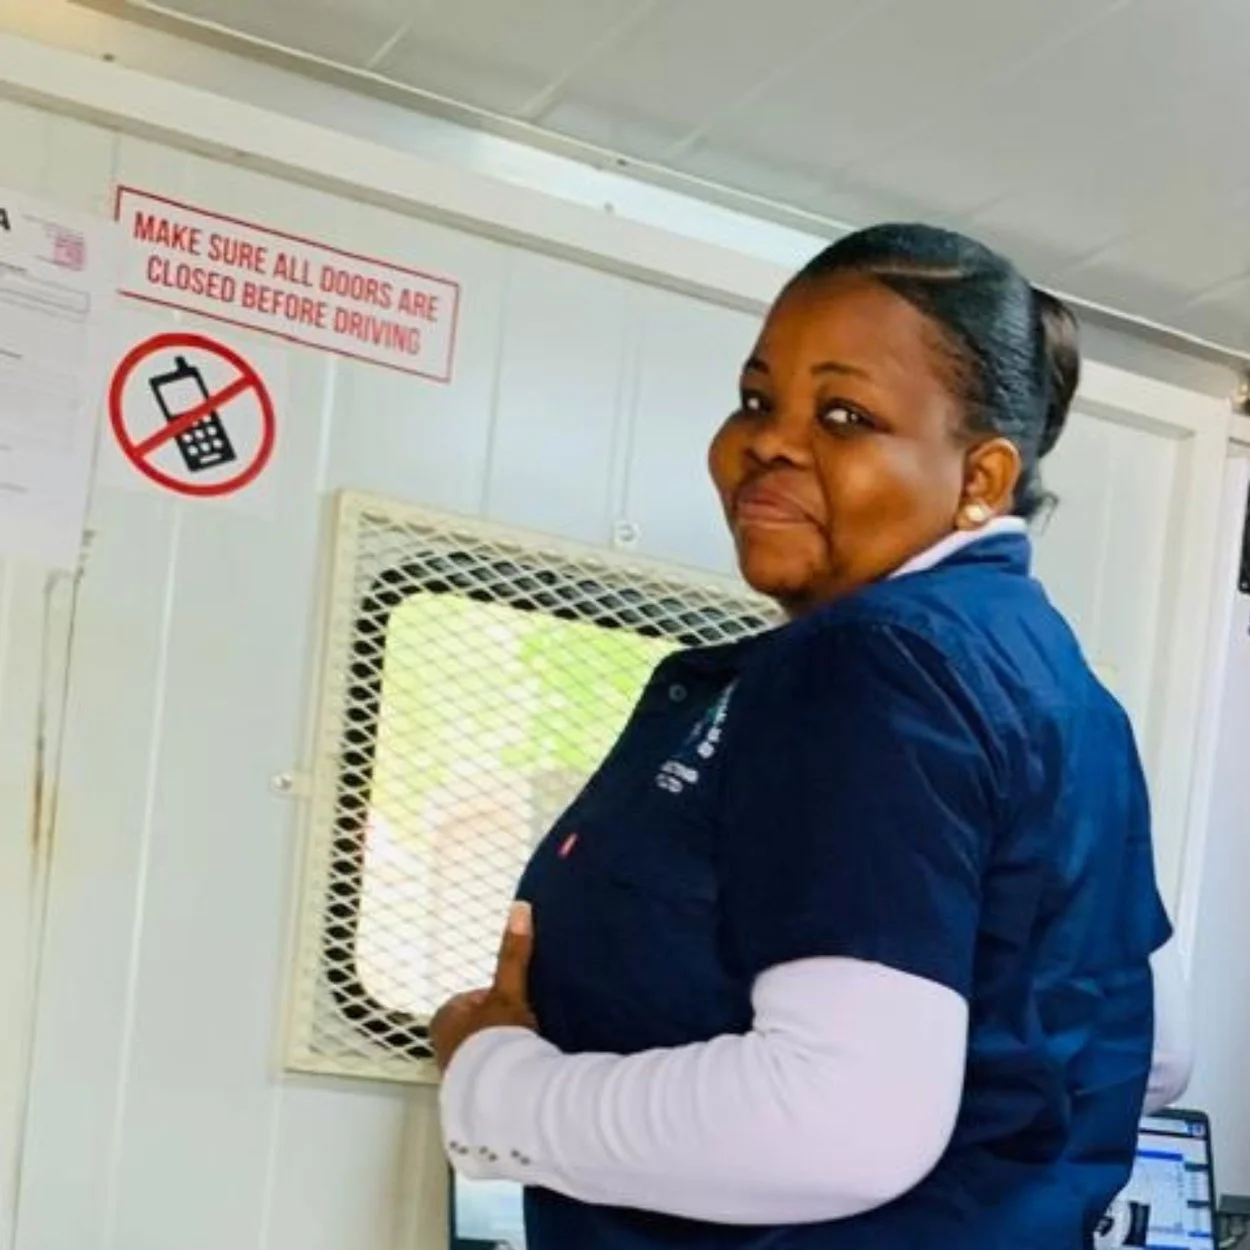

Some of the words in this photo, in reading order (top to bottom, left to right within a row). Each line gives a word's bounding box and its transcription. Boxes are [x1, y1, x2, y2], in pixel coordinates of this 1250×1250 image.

[133, 211, 202, 256] MAKE
[208, 233, 269, 274] SURE
[272, 252, 313, 288] ALL
[320, 265, 393, 309] DOORS
[398, 287, 439, 322] ARE
[147, 254, 236, 303] CLOSED
[241, 281, 328, 329] BEFORE
[333, 306, 421, 355] DRIVING
